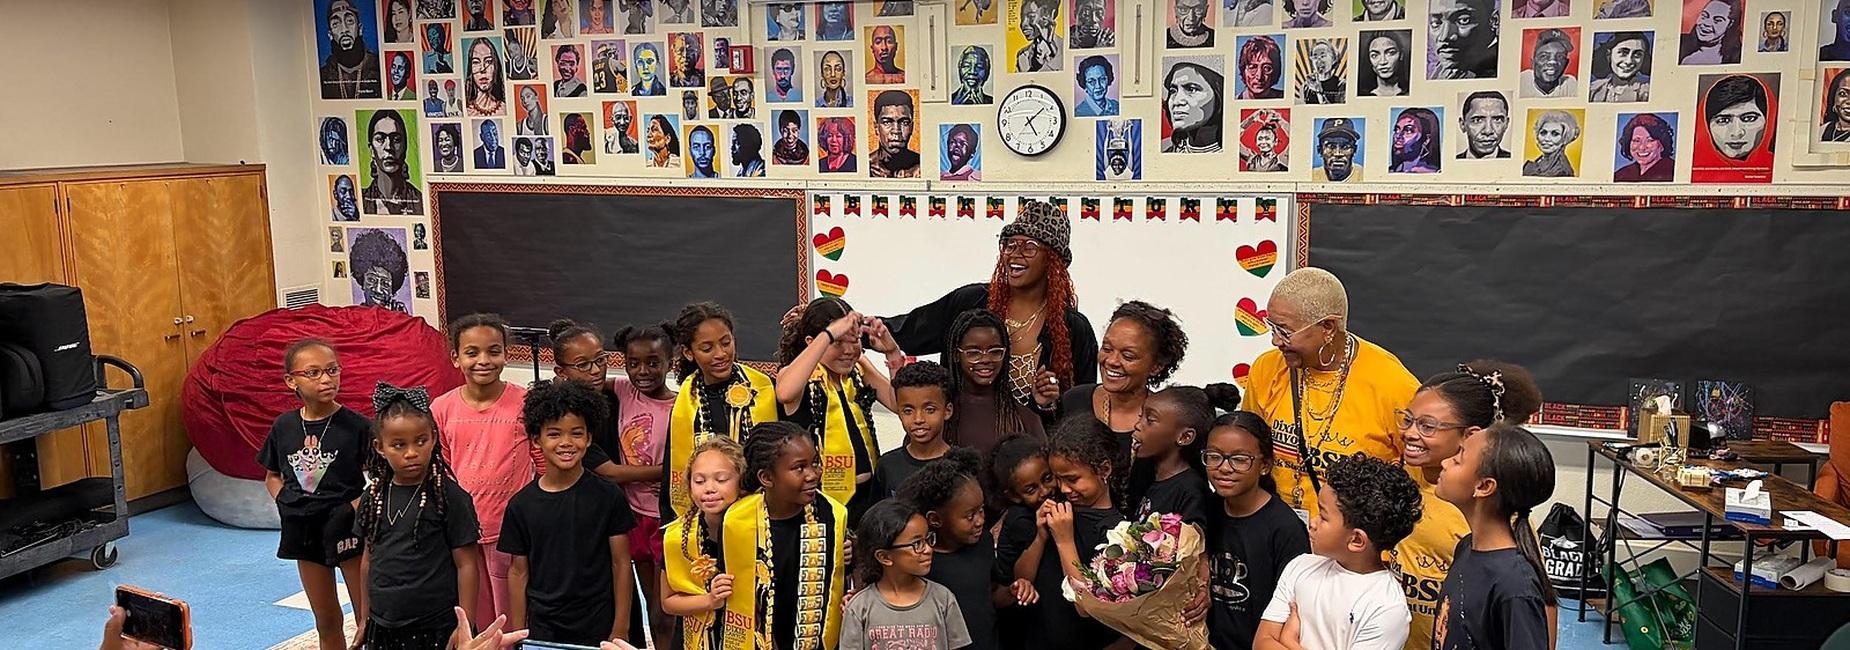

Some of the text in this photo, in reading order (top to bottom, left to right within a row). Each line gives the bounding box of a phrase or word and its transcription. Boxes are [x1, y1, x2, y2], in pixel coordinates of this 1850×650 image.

[1024, 90, 1033, 98] 12
[1001, 119, 1008, 127] 9
[1052, 116, 1058, 125] 3
[1334, 119, 1343, 127] P
[1005, 133, 1012, 142] 8
[1048, 130, 1054, 138] 4
[1027, 145, 1034, 153] 6
[1272, 419, 1298, 435] Dixi
[825, 455, 854, 469] BSU
[337, 537, 358, 554] GAP
[1402, 572, 1441, 601] BS
[726, 610, 752, 630] BSU
[869, 627, 905, 641] GREAT
